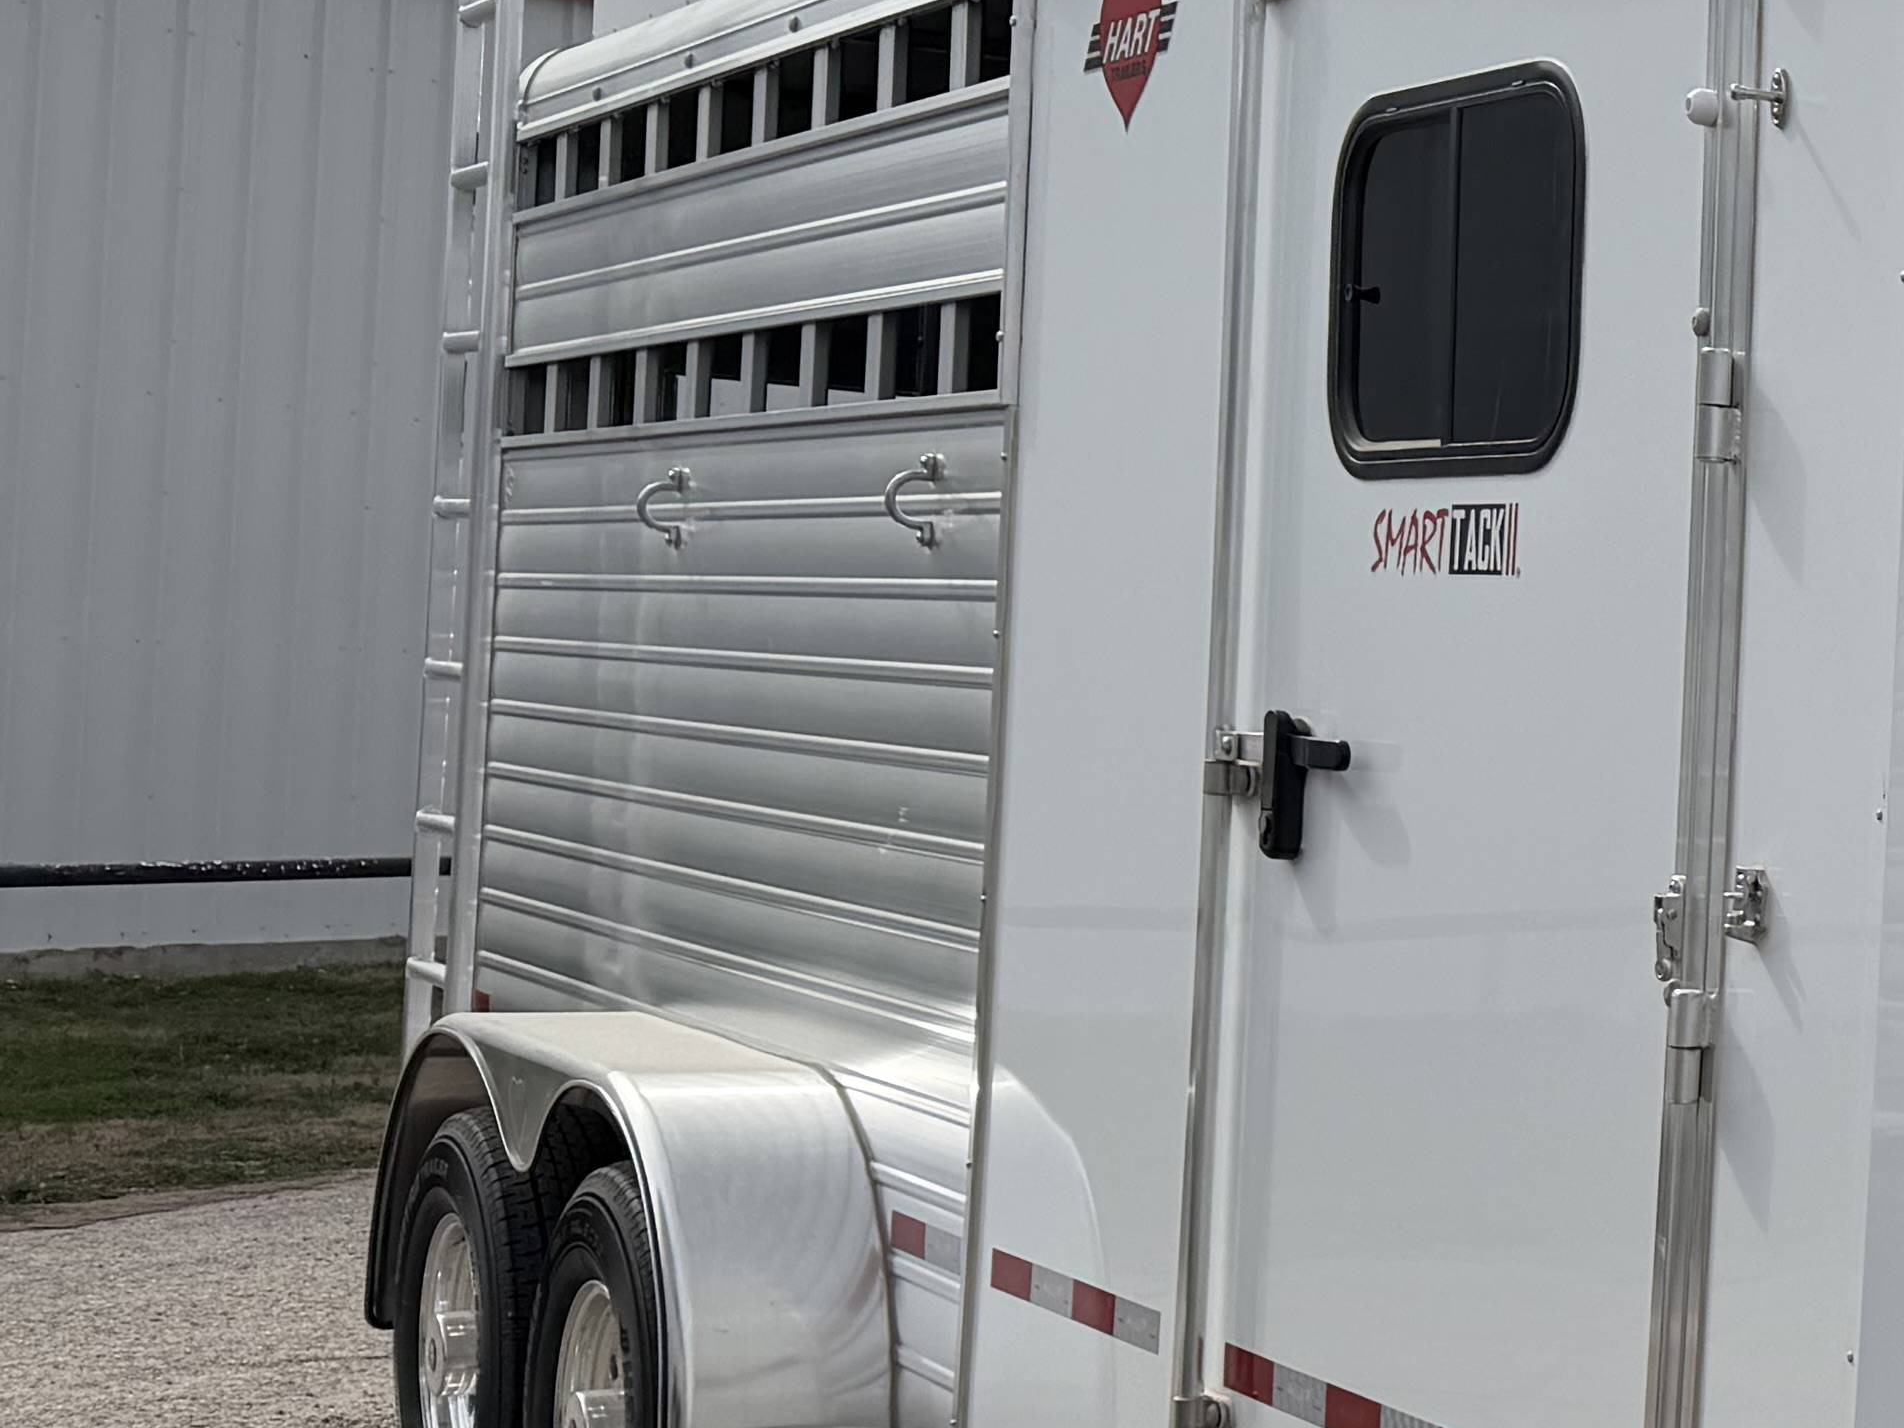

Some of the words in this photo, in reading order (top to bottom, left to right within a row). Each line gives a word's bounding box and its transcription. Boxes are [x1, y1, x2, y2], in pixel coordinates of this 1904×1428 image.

[1102, 8, 1161, 65] HART
[1371, 507, 1449, 577] SMART
[1451, 507, 1505, 573] TACK
